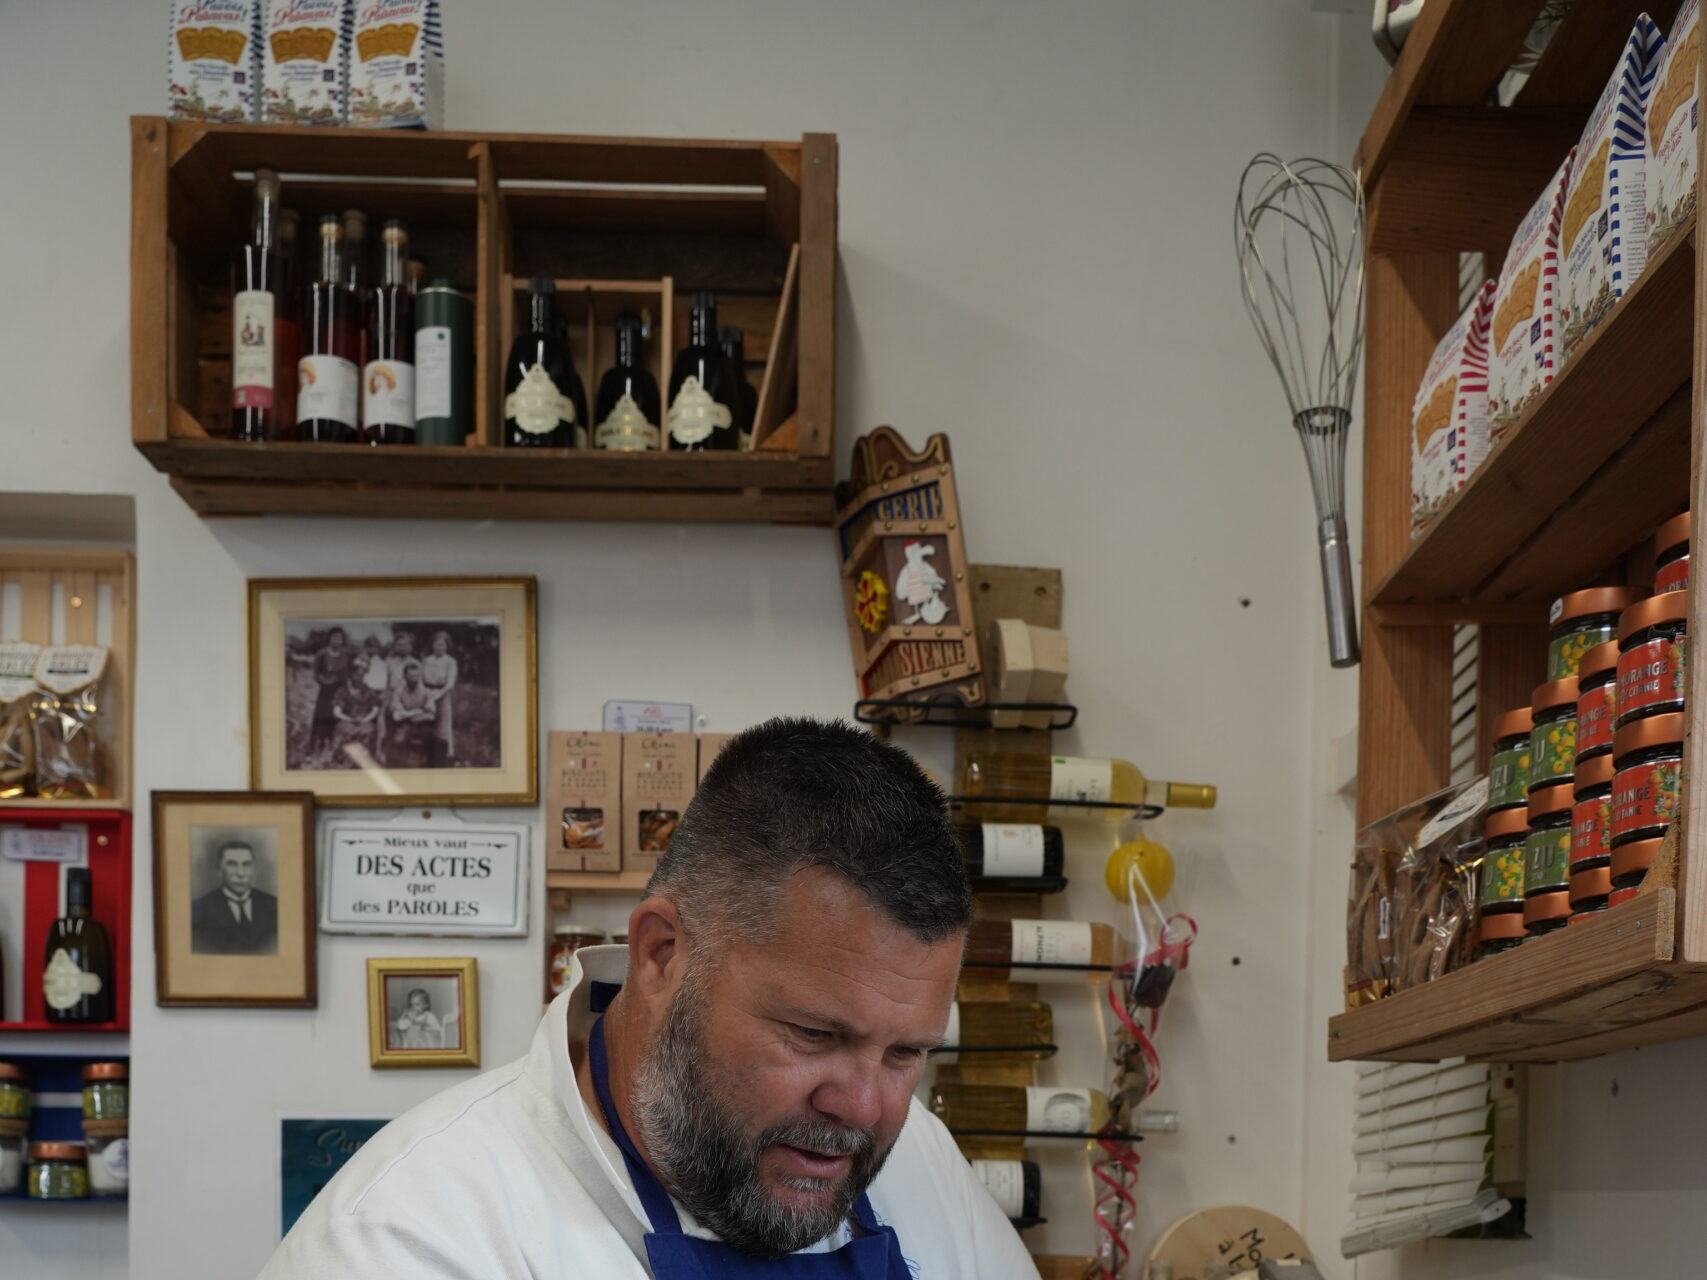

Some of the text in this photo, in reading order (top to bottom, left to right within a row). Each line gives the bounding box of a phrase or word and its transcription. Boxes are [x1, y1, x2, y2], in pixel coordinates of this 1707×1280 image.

[384, 836, 468, 849] Mieux vaut
[356, 853, 493, 879] DES ACTES
[406, 882, 437, 896] que
[352, 899, 480, 916] des PAROLES
